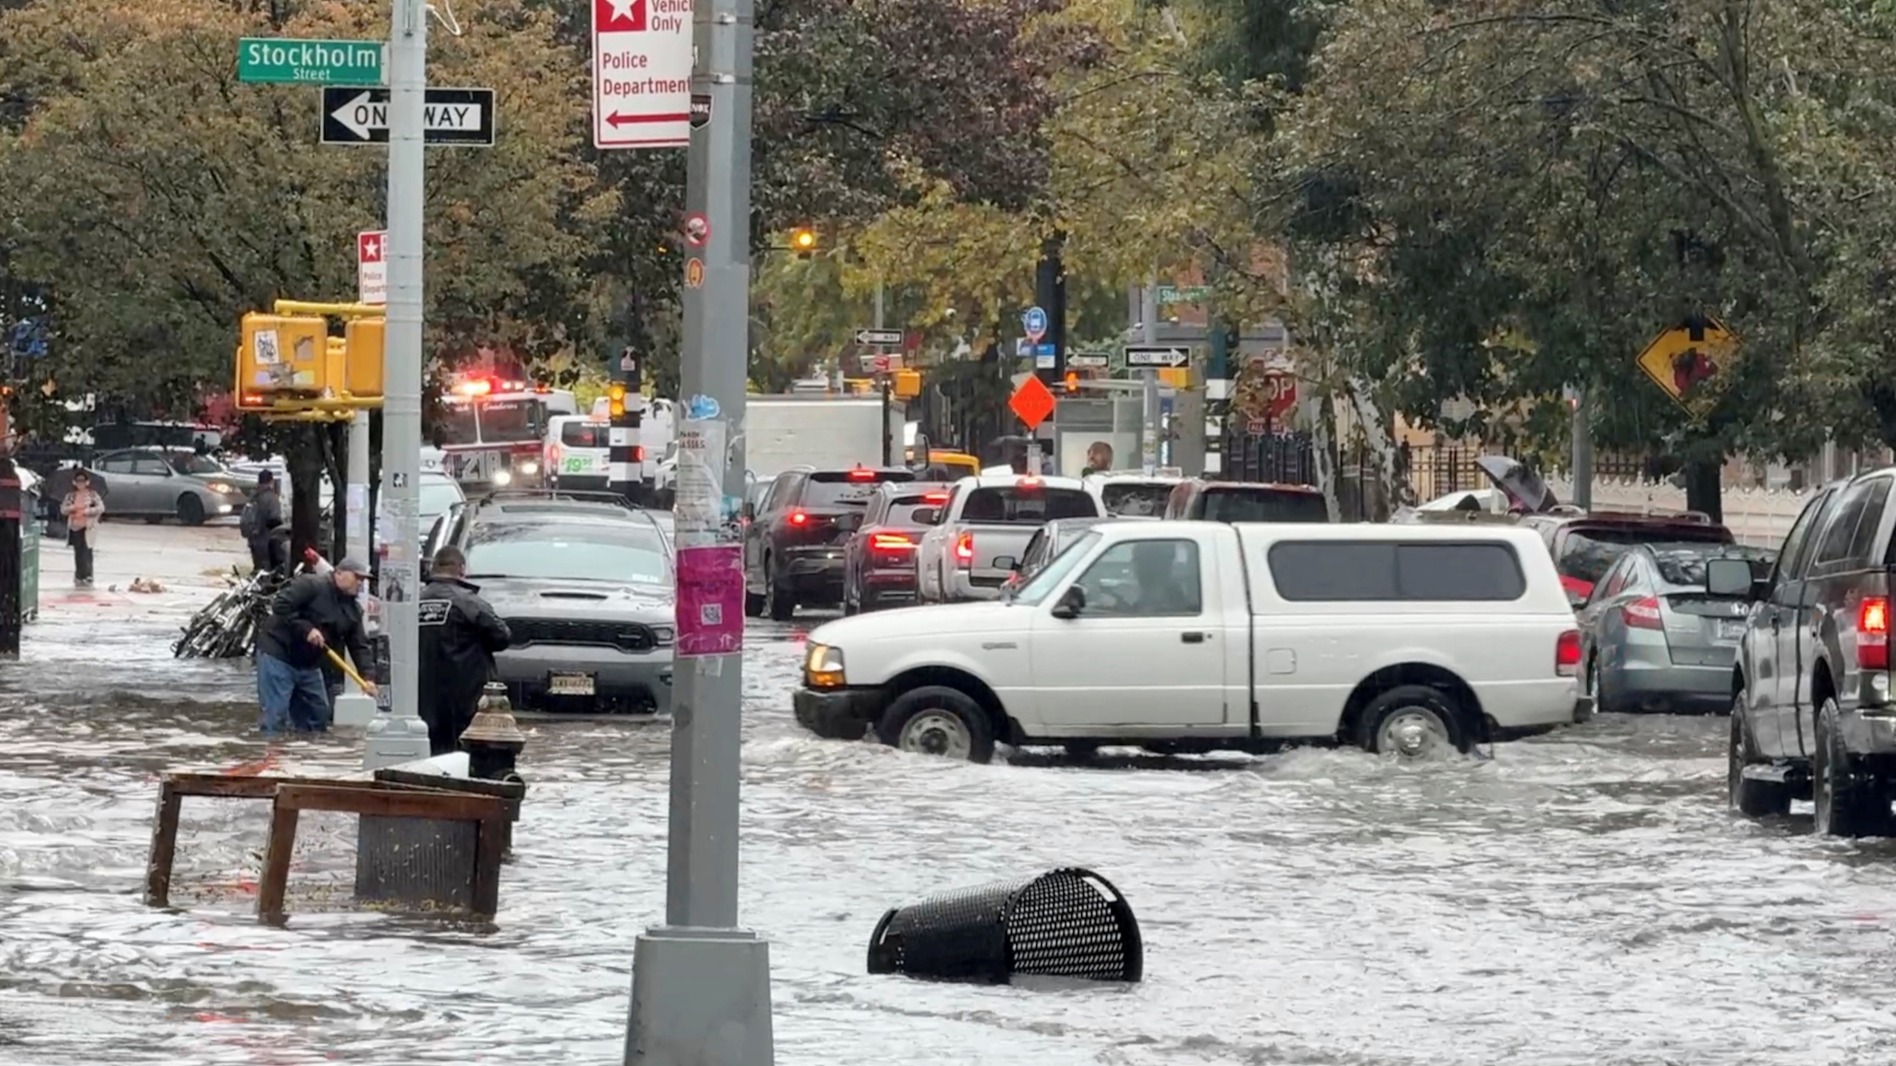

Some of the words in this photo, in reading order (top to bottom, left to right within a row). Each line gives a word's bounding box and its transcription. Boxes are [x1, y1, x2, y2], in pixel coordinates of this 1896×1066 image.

[652, 0, 692, 13] Vehicl
[651, 15, 682, 34] Only
[248, 43, 376, 68] Stockholm
[602, 52, 648, 69] Police
[292, 68, 331, 80] Street
[354, 105, 387, 126] ON
[364, 285, 388, 295] Depart
